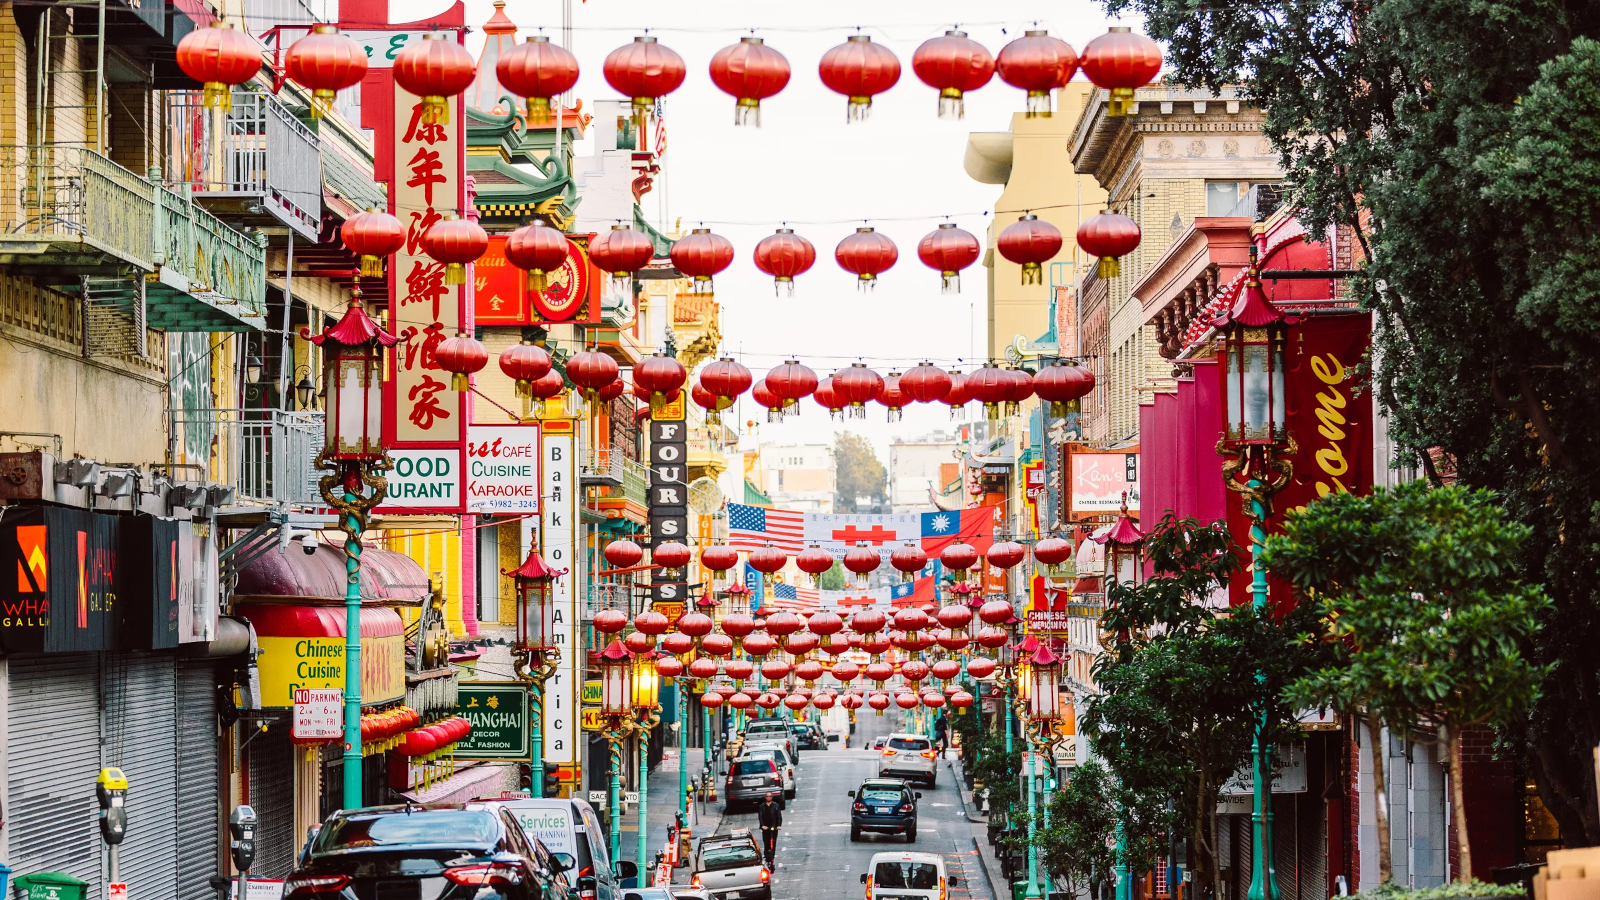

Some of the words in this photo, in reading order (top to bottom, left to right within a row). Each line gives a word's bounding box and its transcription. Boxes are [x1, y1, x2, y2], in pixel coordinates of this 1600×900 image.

[502, 443, 532, 457] CAFÉ
[471, 460, 531, 477] CUISINE
[658, 424, 679, 504] FOUR
[1077, 457, 1124, 490] Kan's
[384, 482, 454, 498] URANT
[550, 446, 563, 527] Bank
[1029, 611, 1066, 620] CHINESE
[295, 639, 343, 658] Chinese
[297, 661, 341, 679] Cuisine
[295, 690, 309, 703] NO
[310, 693, 340, 702] PARKING
[299, 718, 312, 726] MON
[326, 718, 336, 726] FRI
[520, 813, 565, 829] Services
